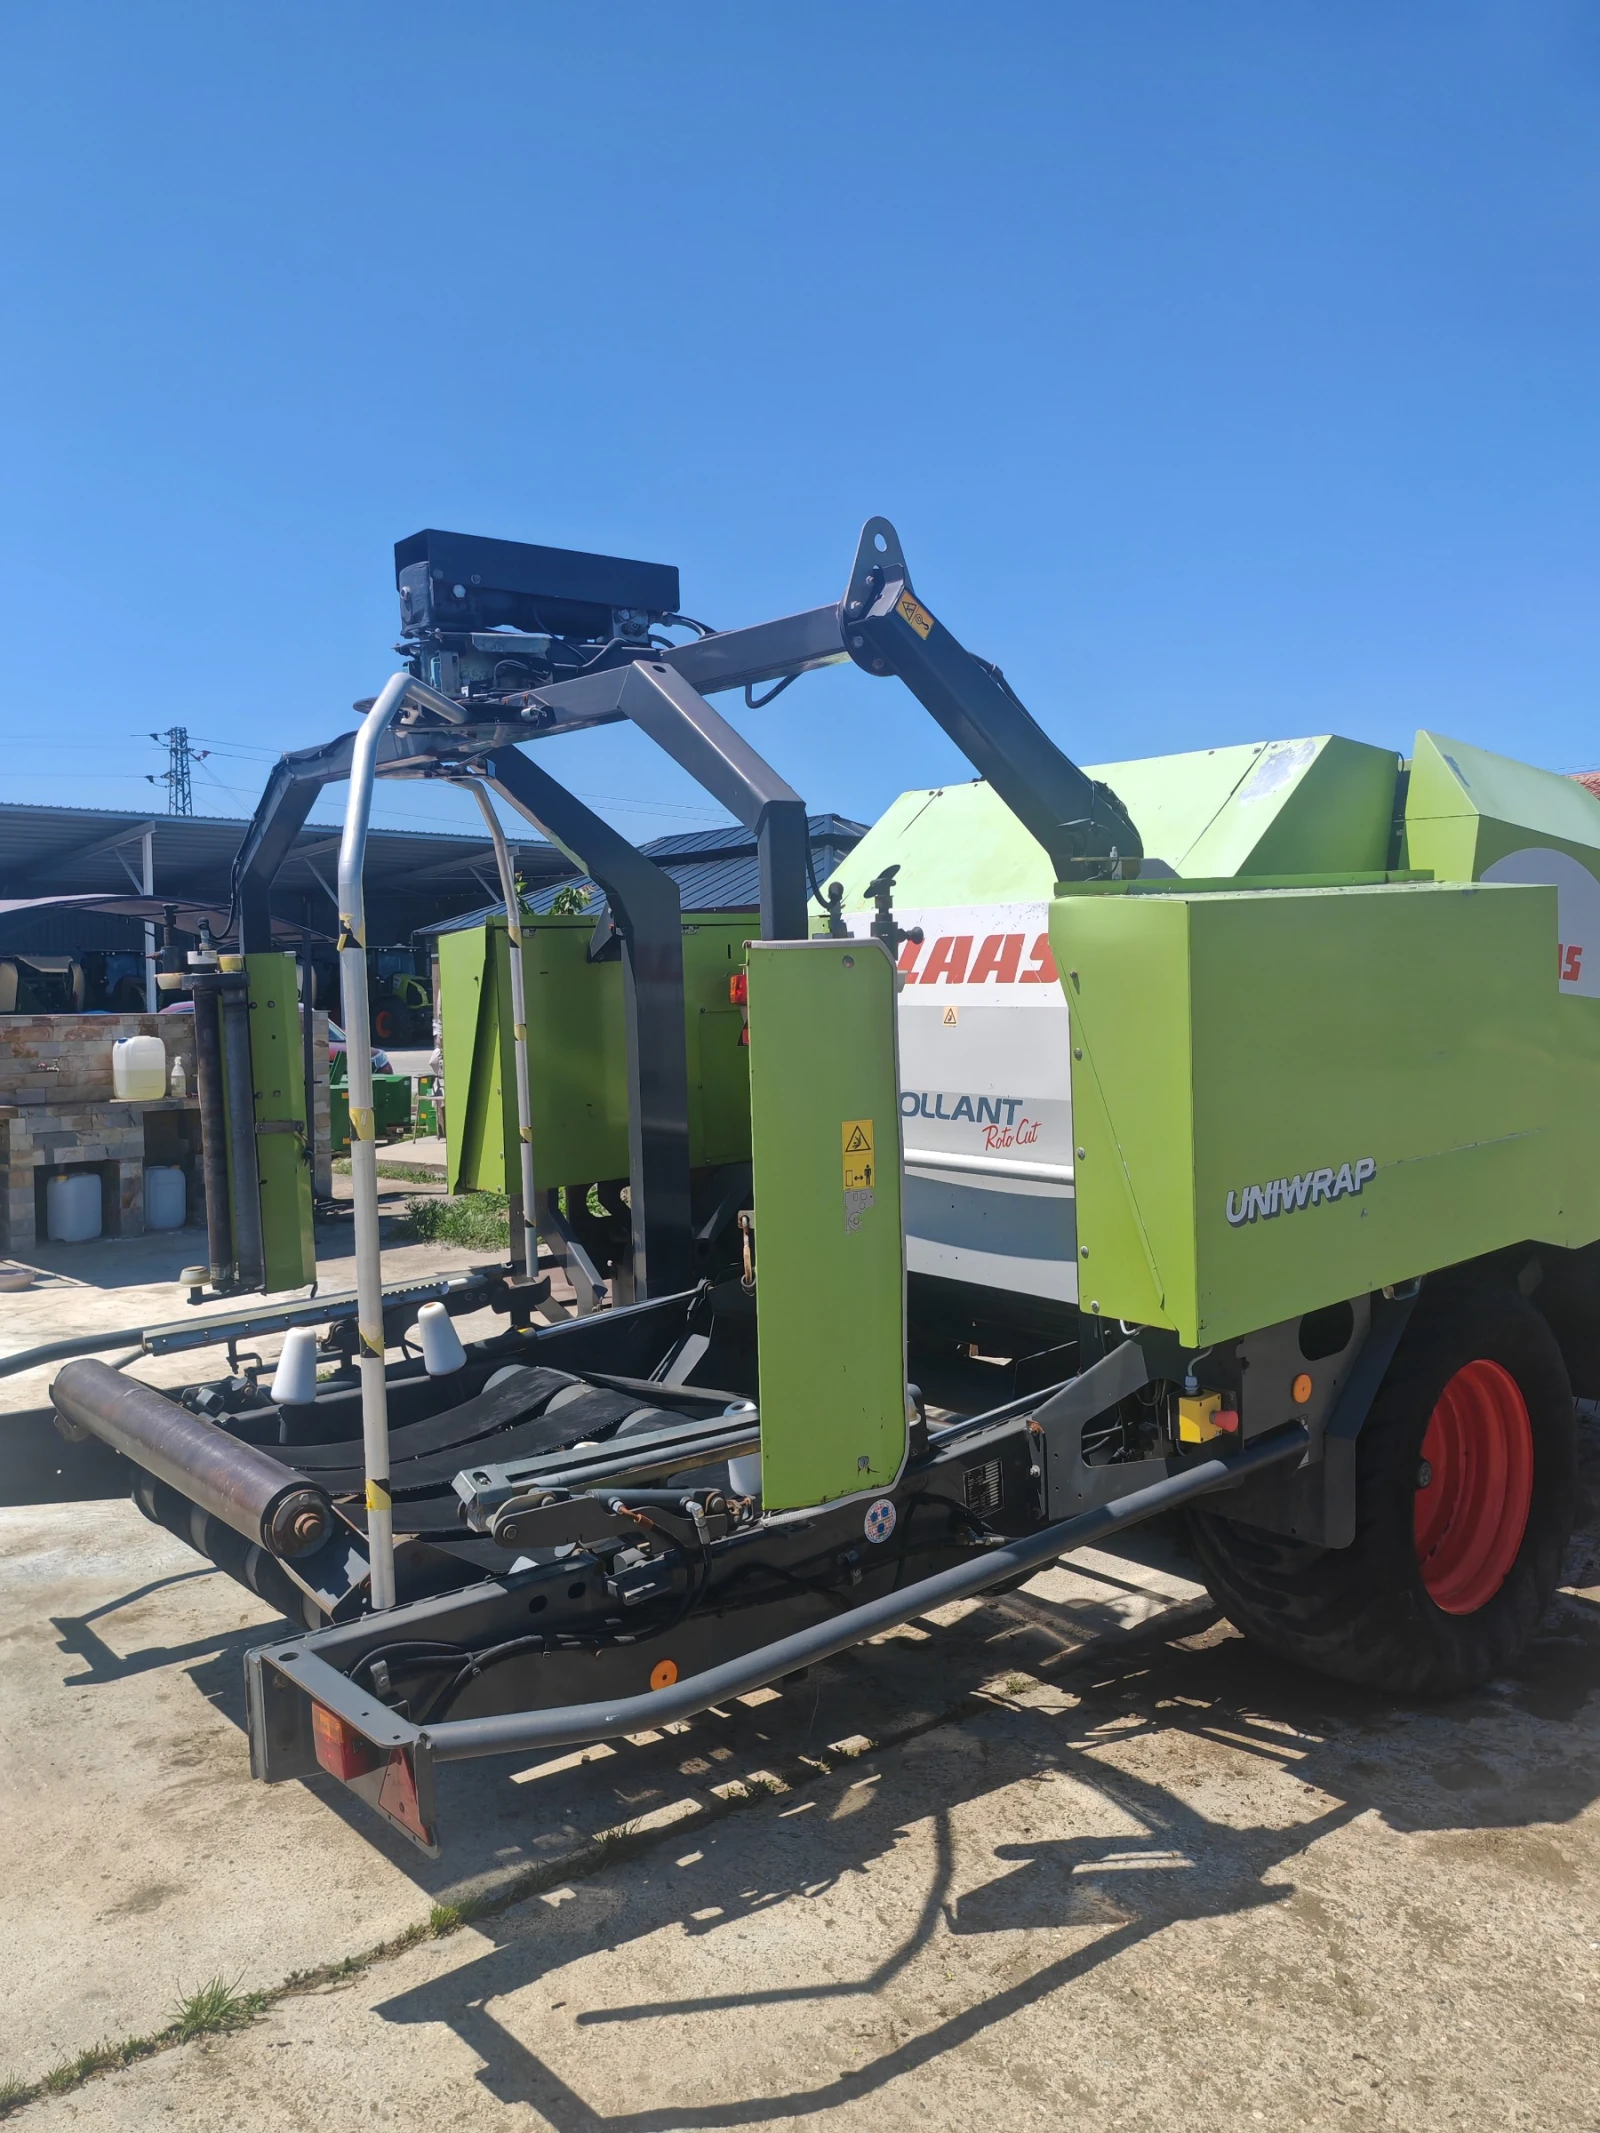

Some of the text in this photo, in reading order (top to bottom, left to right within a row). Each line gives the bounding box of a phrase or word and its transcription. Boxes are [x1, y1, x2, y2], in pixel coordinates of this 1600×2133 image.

[900, 1092, 1023, 1125] OLLANT
[982, 1118, 1042, 1151] Roto Cut
[1226, 1157, 1377, 1228] UNIWRAP
